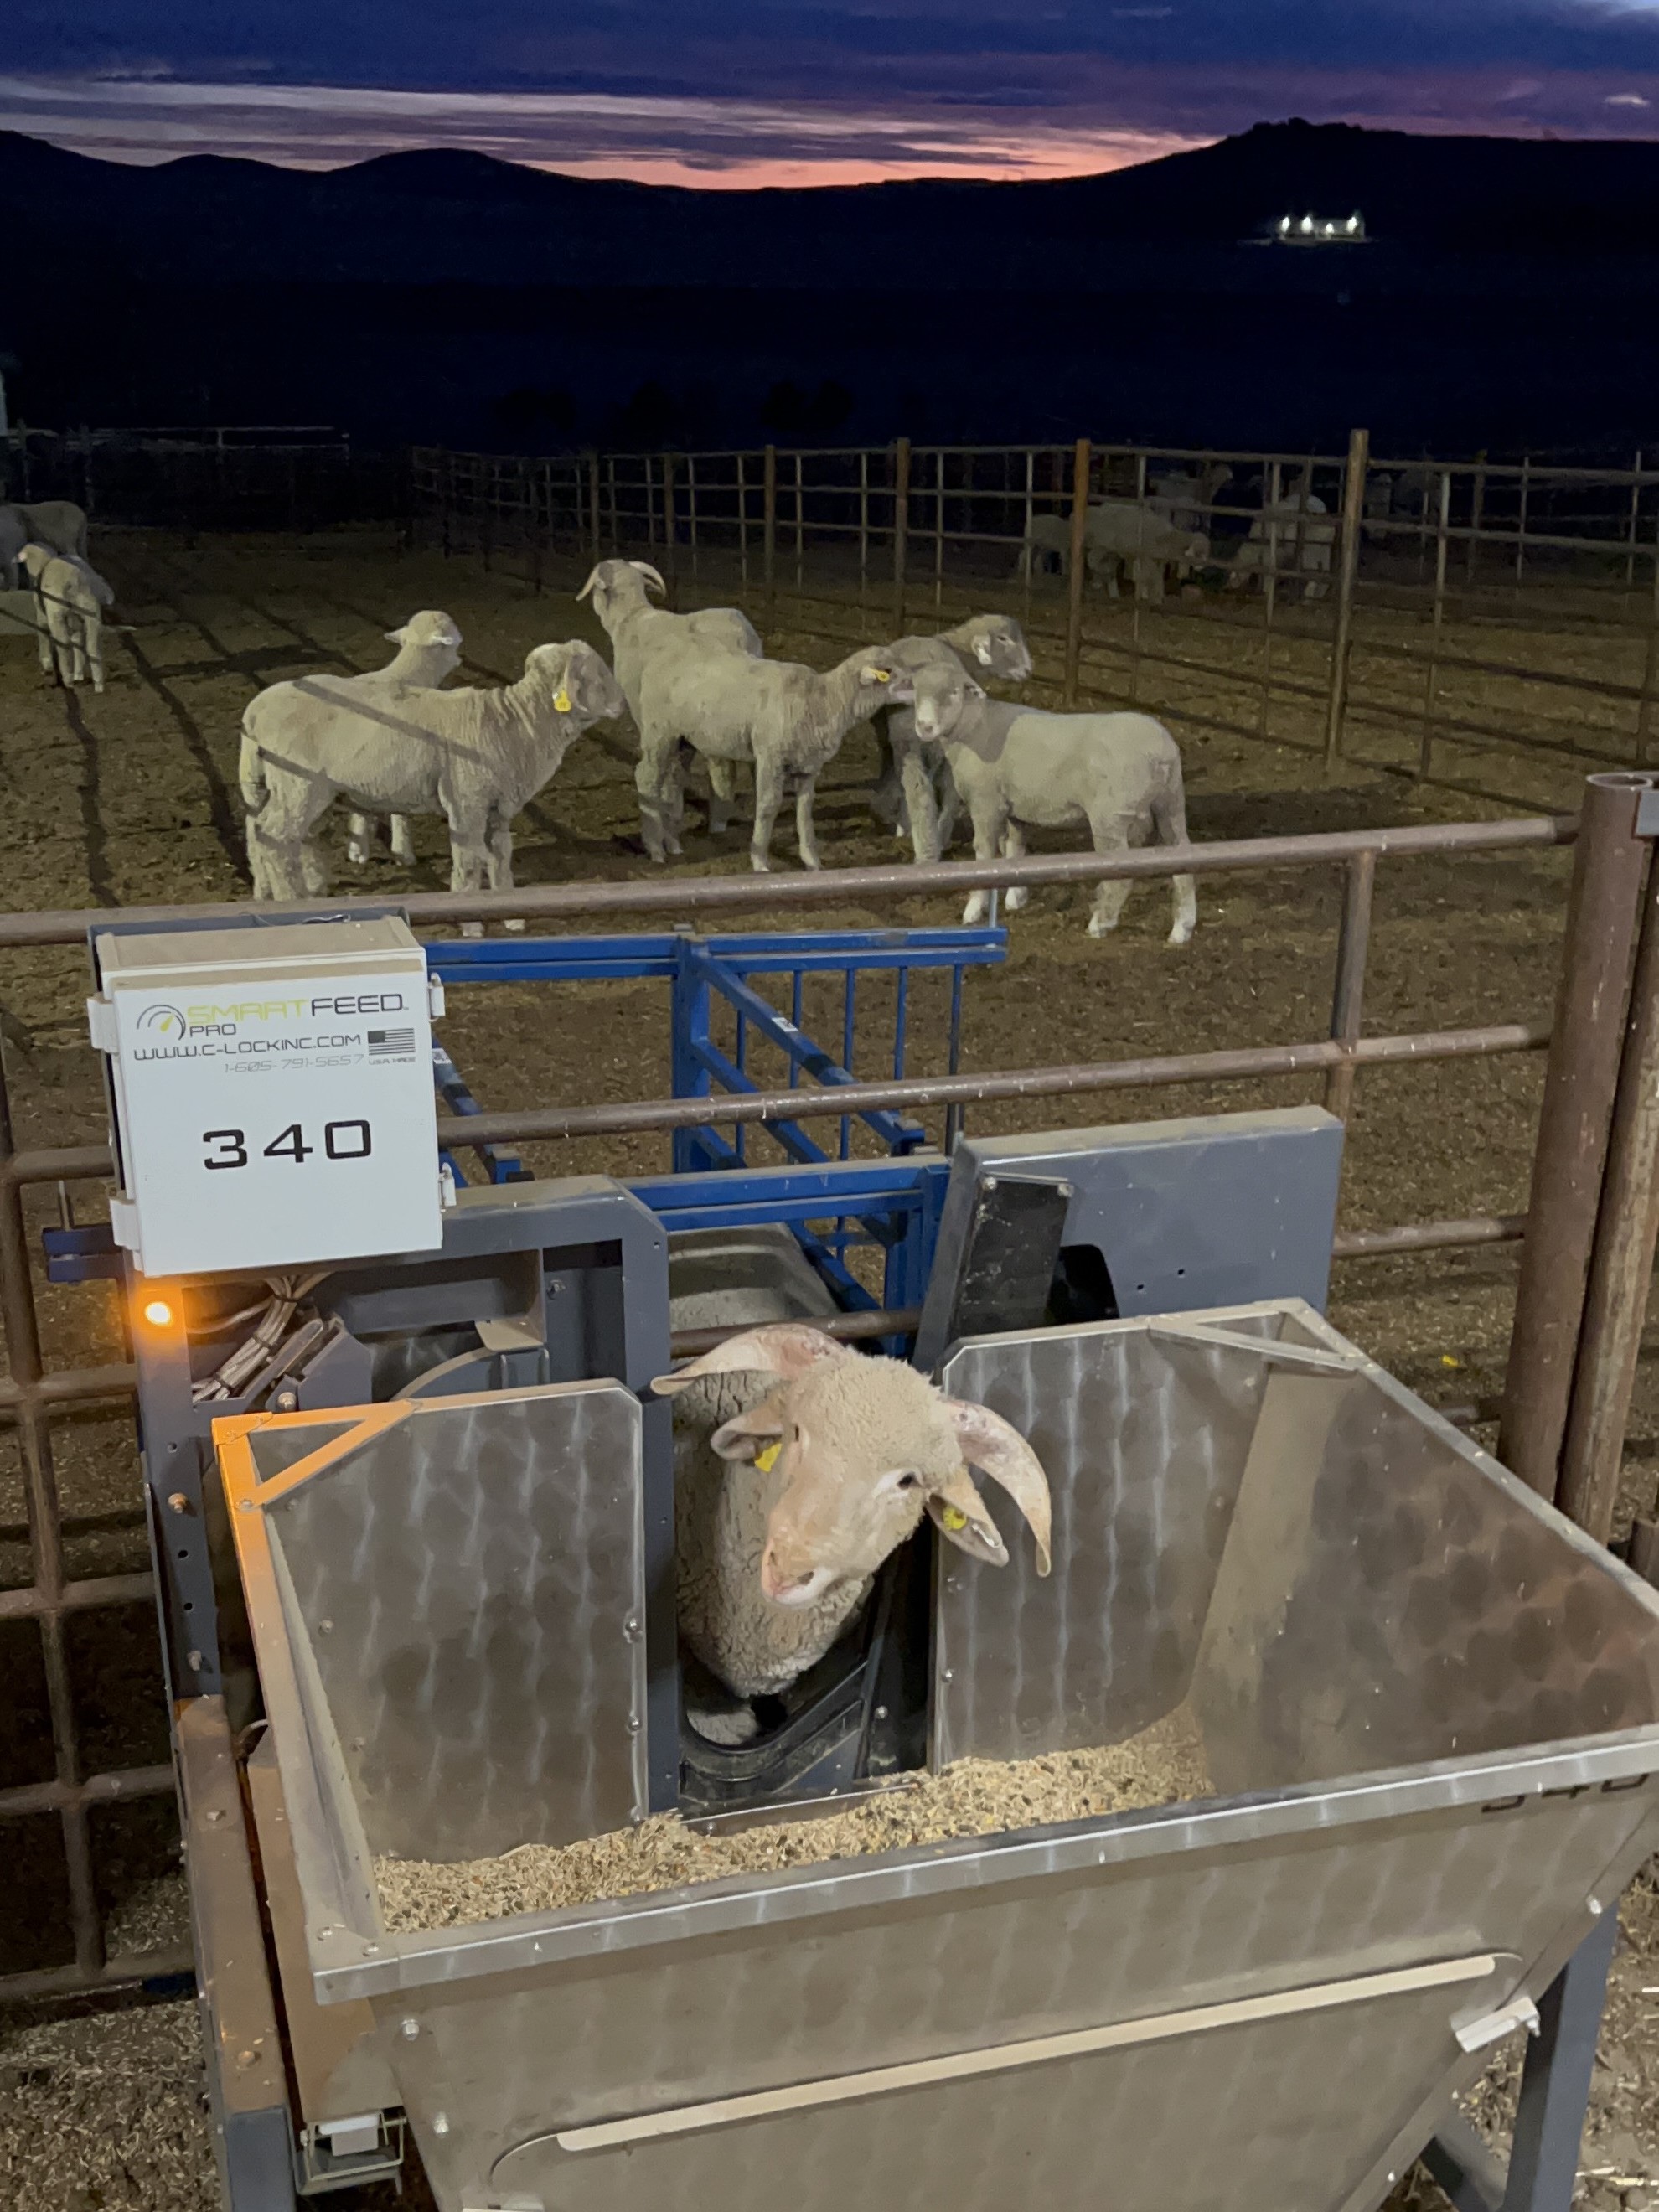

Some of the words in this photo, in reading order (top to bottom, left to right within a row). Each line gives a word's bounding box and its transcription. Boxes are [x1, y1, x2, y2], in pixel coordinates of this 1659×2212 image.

[189, 1023, 237, 1037] PRO
[134, 1034, 361, 1061] WWW.C-LOCKINC.COM
[225, 1053, 364, 1073] 1-605-791-5657
[203, 1119, 371, 1170] 340
